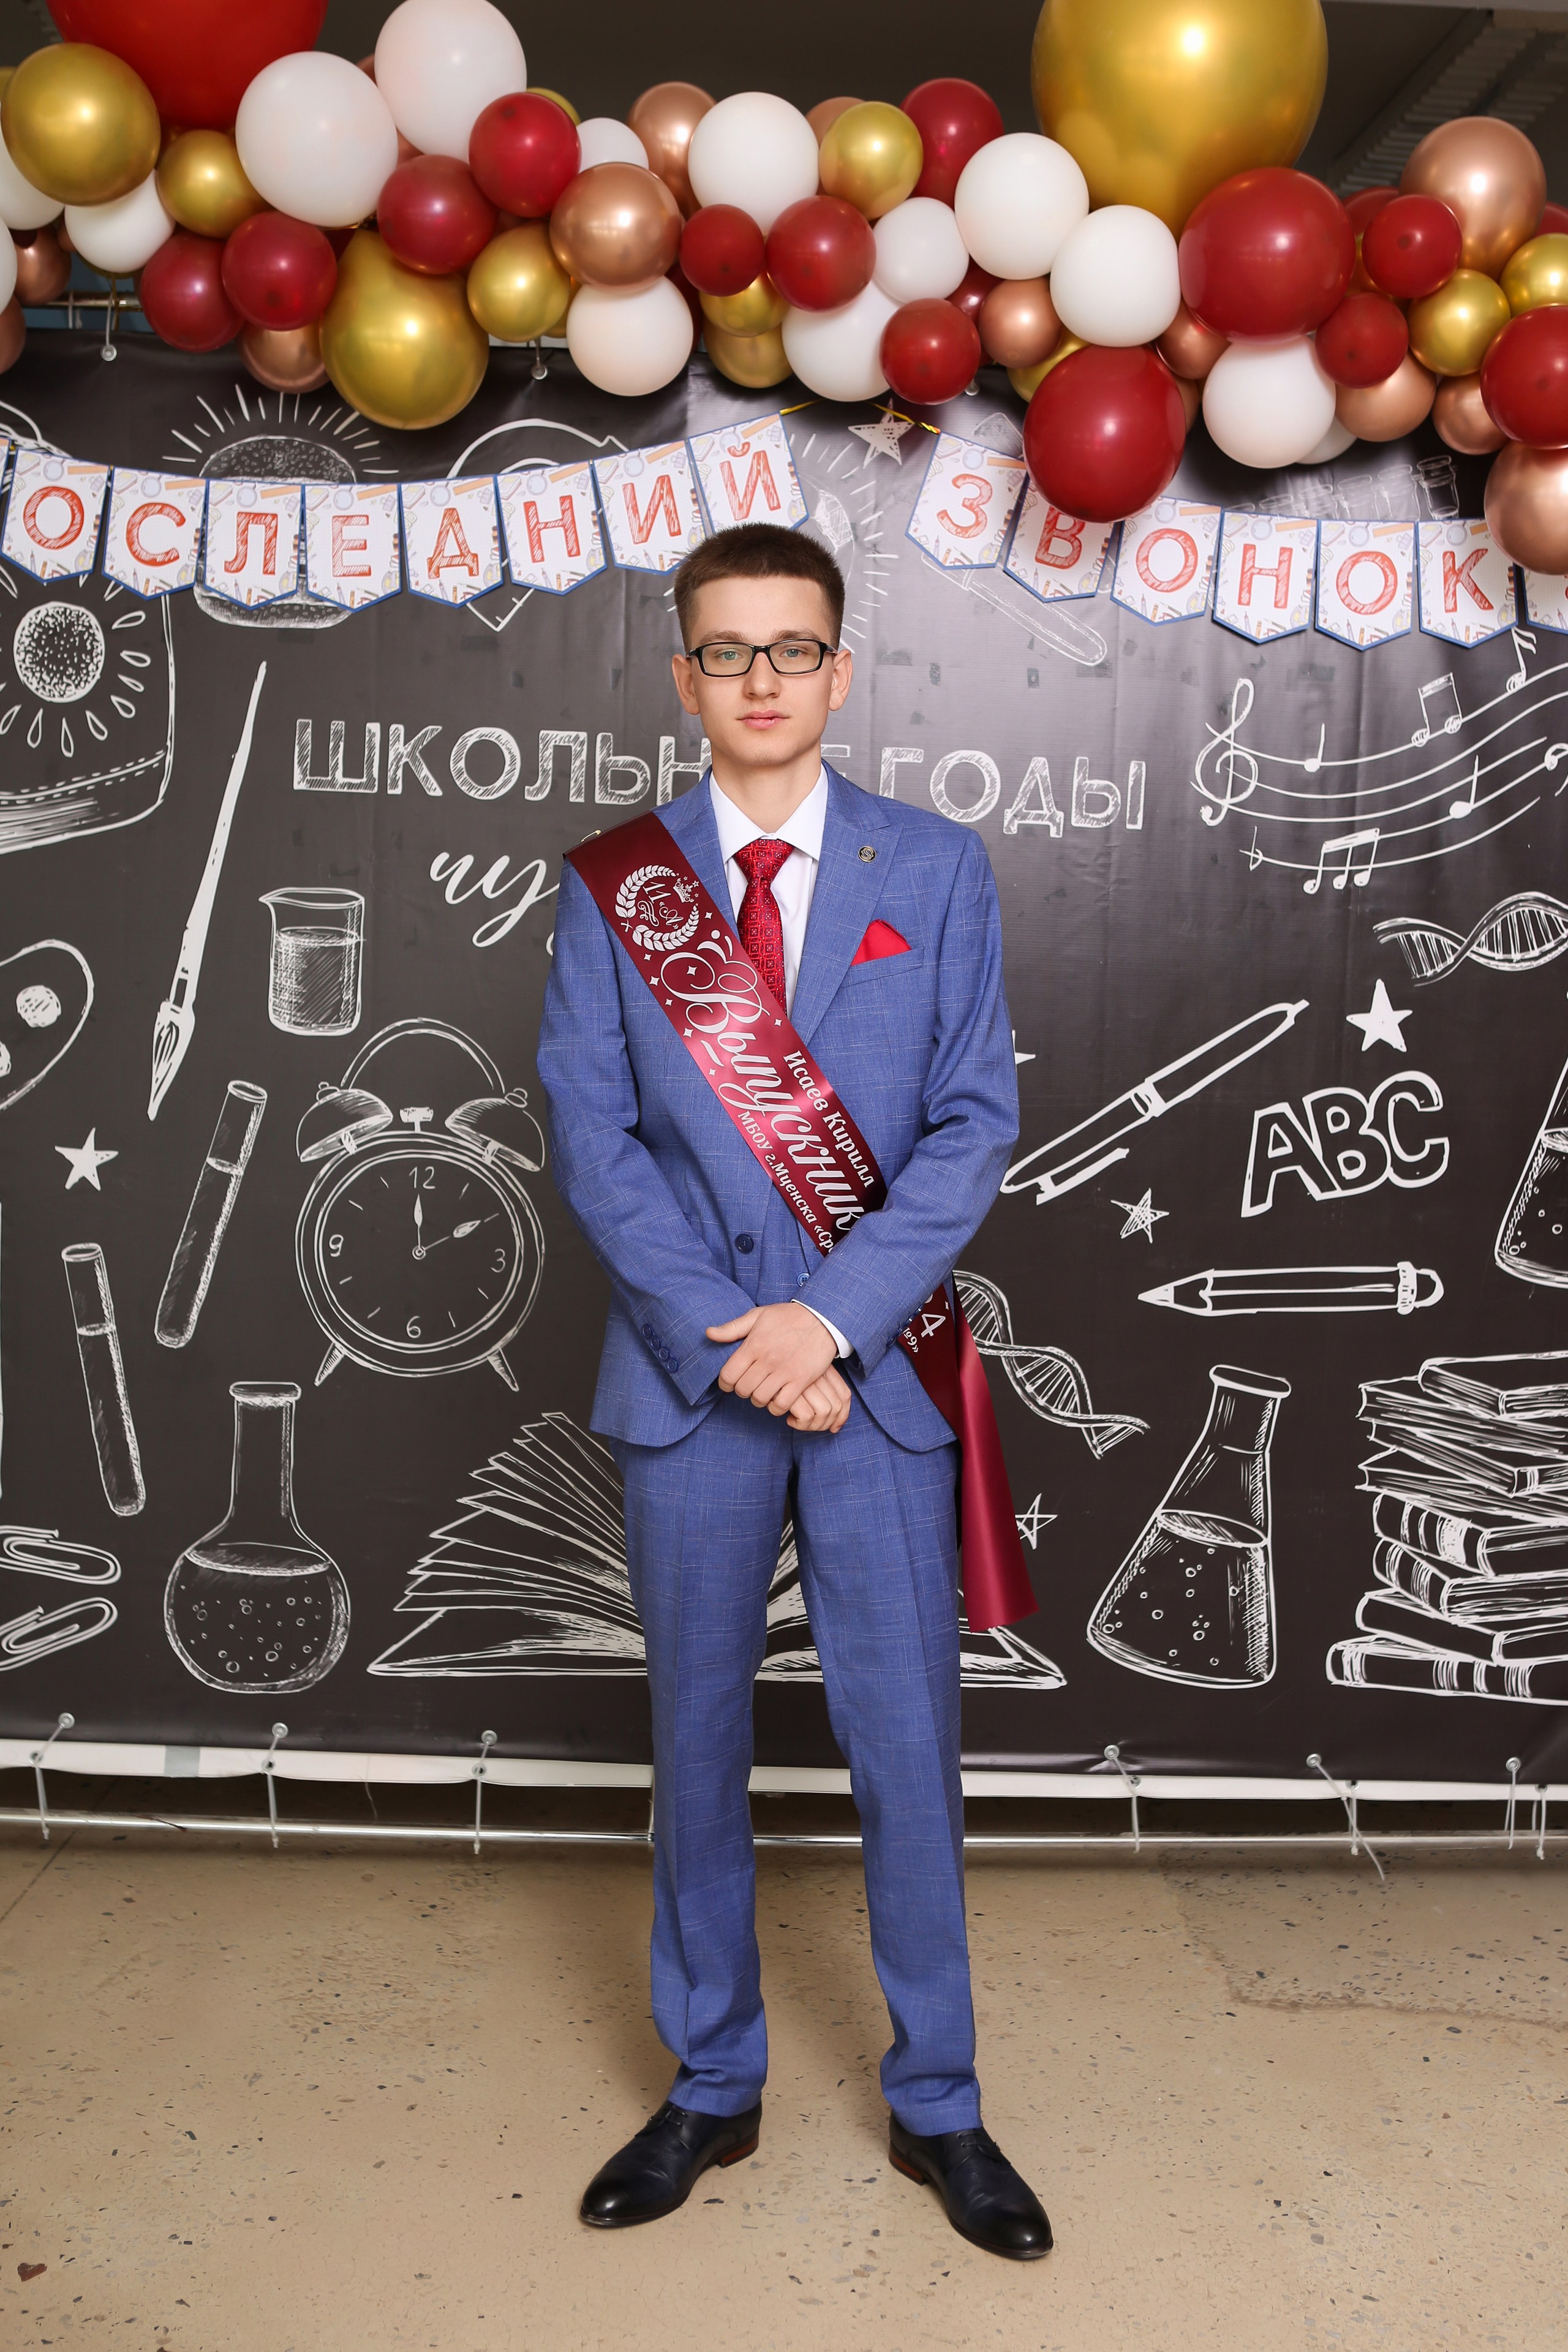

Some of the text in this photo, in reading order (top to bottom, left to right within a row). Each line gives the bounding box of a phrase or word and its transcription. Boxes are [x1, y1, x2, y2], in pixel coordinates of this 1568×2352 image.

[23, 442, 1493, 614] ОСЛЕДНИЙ ЗВОНОК
[293, 718, 1146, 838] ШКОЛЬН ГОДЫ
[660, 941, 864, 1231] Выпускник
[783, 1050, 875, 1188] Исаев Кирилл
[737, 1111, 774, 1150] МБОУ
[1241, 1071, 1449, 1218] ABC
[409, 1166, 436, 1189] 12
[329, 1234, 344, 1257] 9
[491, 1248, 506, 1273] 3
[406, 1316, 421, 1338] 6
